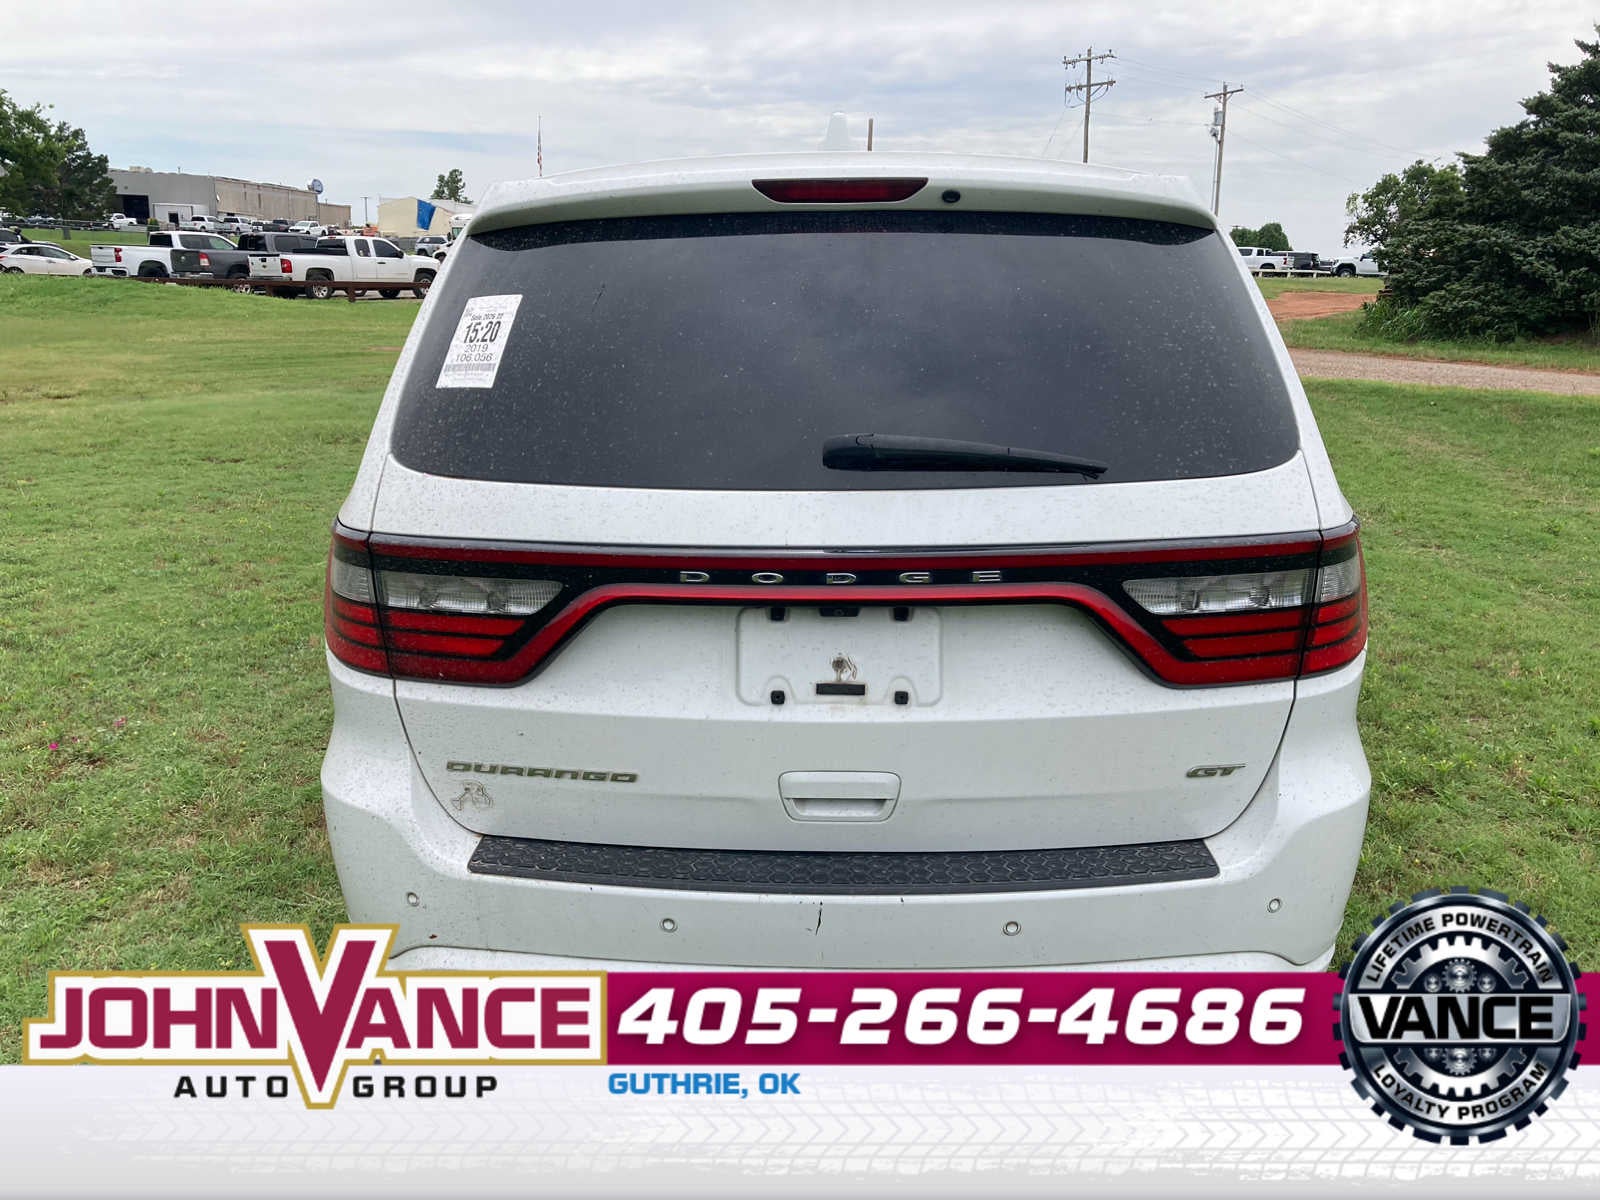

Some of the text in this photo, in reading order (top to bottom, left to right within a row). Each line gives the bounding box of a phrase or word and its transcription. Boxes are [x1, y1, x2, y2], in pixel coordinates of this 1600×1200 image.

[464, 320, 501, 343] 15:20
[465, 344, 488, 352] 2019
[680, 570, 1001, 584] DODGE
[446, 761, 638, 783] DURANGO
[1186, 763, 1246, 778] GT
